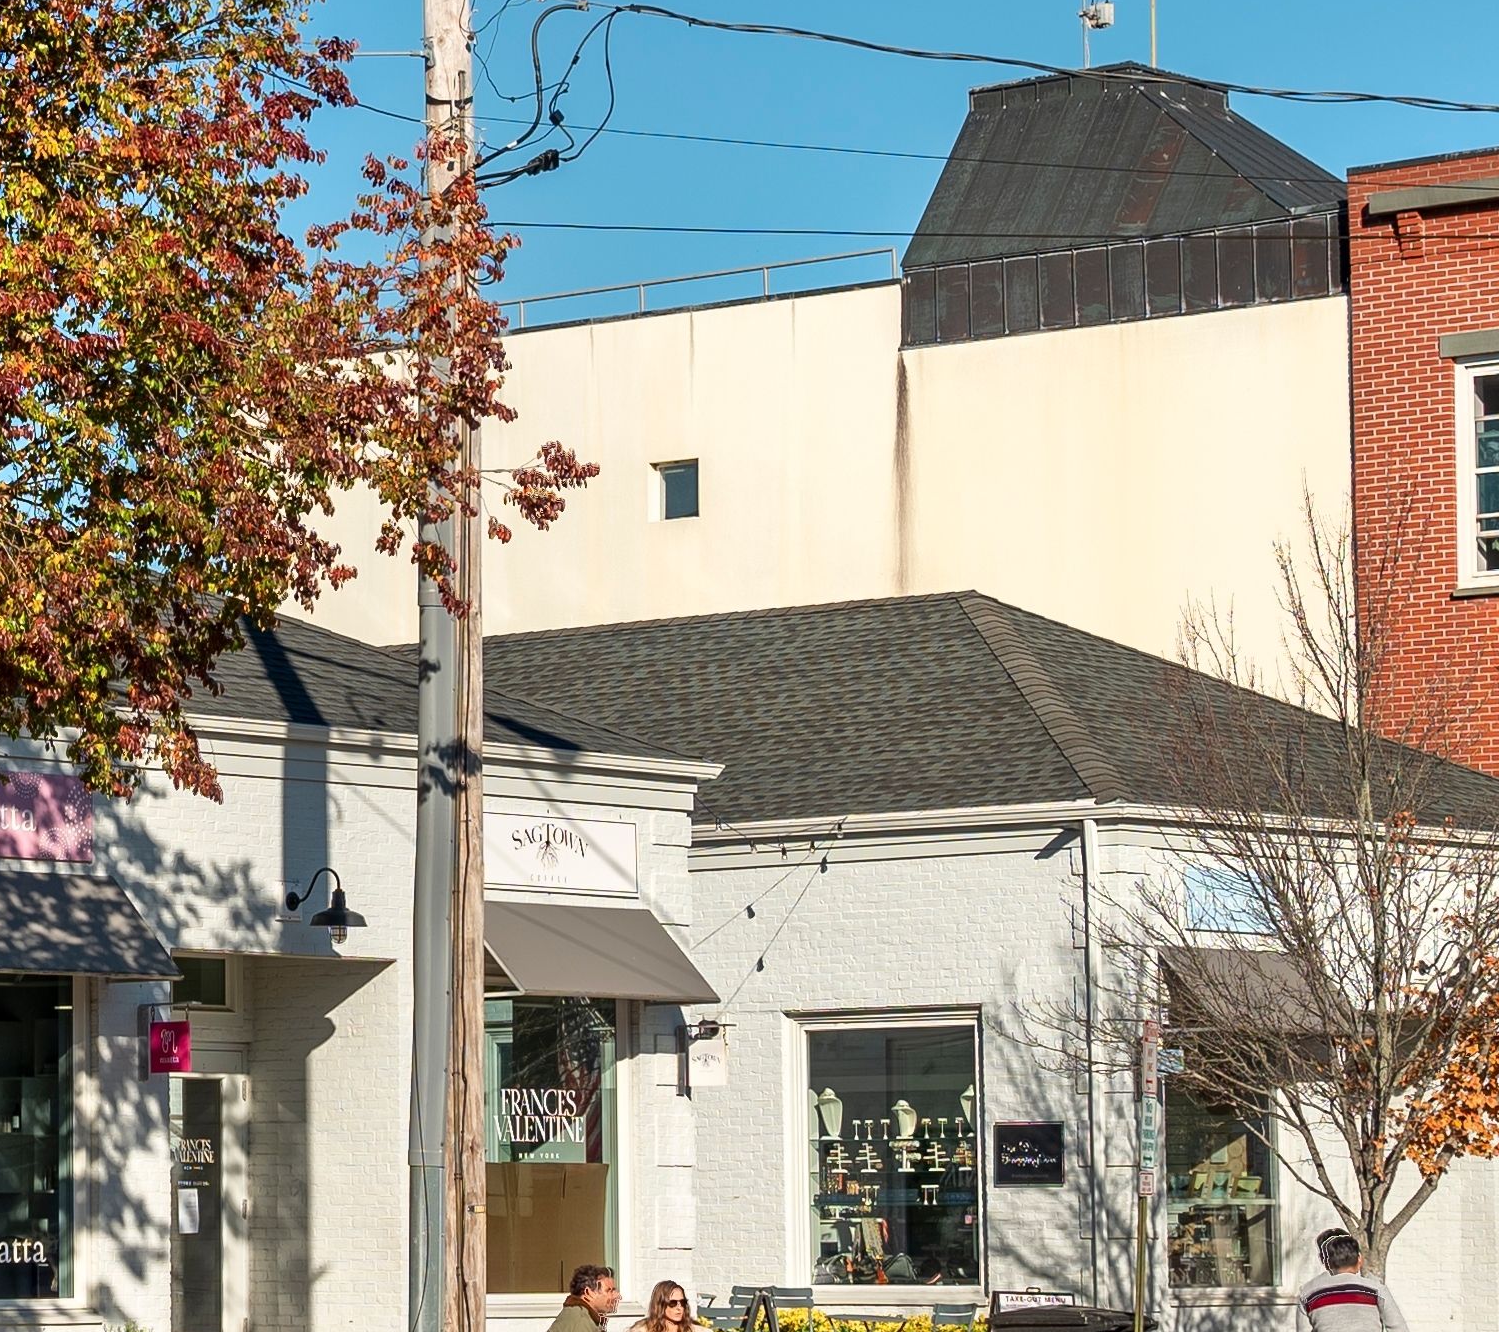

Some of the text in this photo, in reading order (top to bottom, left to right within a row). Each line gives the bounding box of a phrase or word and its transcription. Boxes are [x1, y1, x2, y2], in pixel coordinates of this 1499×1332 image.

[511, 823, 589, 858] SAGTOWN
[500, 1088, 577, 1116] FRANCES
[493, 1115, 584, 1143] VALENTINE
[518, 1152, 560, 1160] NEW YORK
[1044, 1296, 1066, 1304] MENU
